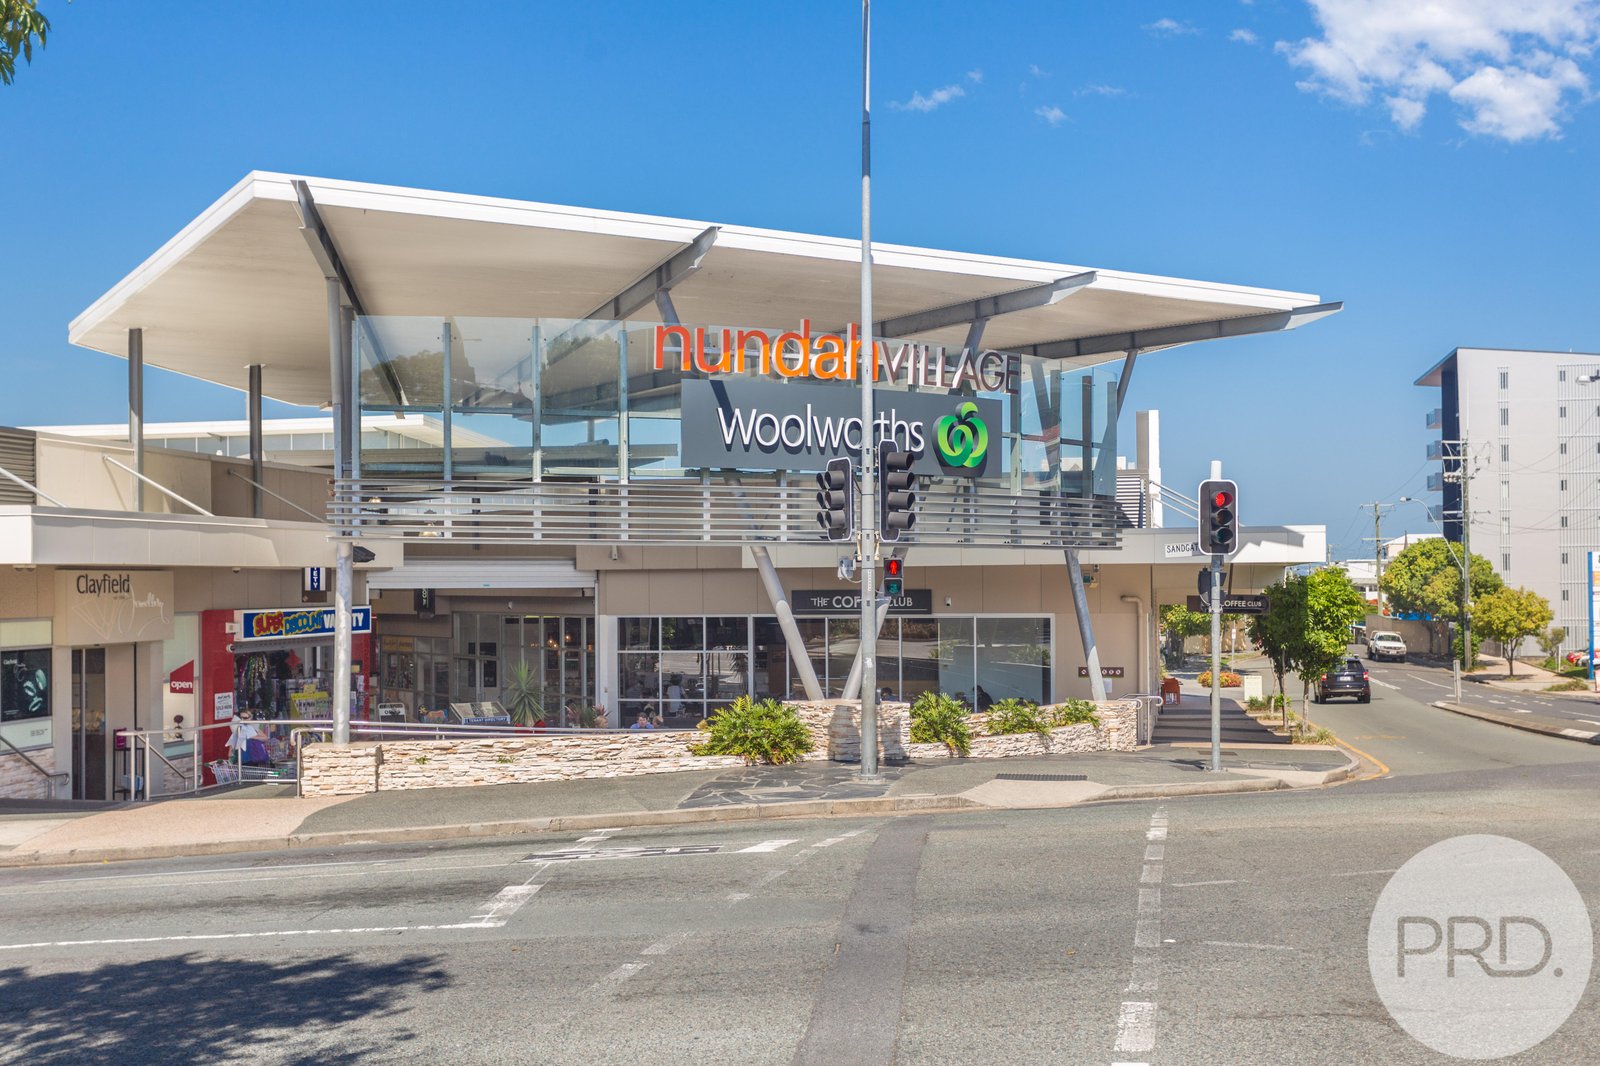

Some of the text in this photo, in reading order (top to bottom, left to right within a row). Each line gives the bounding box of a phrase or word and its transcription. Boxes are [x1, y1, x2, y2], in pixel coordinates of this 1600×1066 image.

[716, 403, 924, 452] Woolwoths
[1166, 543, 1200, 553] SANDGAT
[76, 573, 130, 598] Clayfield
[810, 597, 829, 607] THE
[254, 610, 364, 635] SUPER DISCOUNT VATY
[171, 681, 193, 690] open
